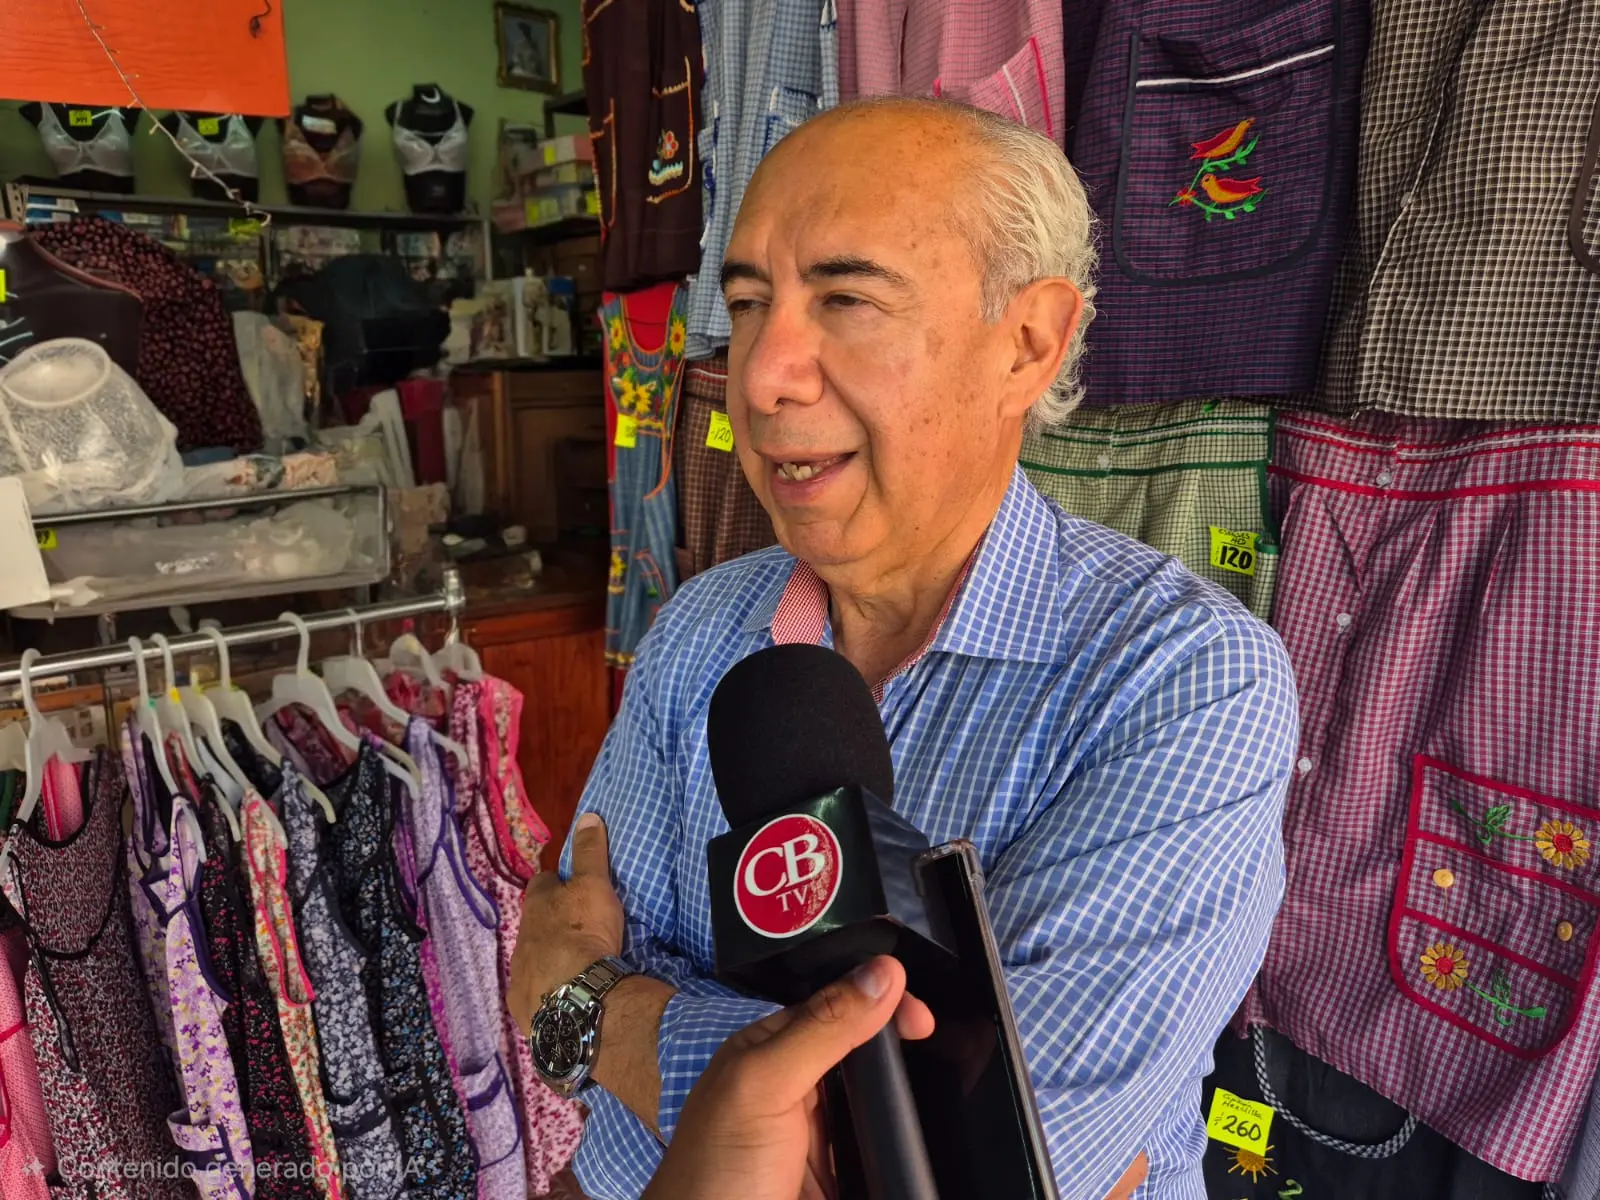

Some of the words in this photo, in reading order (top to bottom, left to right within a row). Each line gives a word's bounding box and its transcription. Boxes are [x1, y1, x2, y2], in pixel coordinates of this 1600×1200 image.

[1219, 545, 1253, 569] 120
[744, 833, 825, 896] CB
[775, 885, 809, 912] TV
